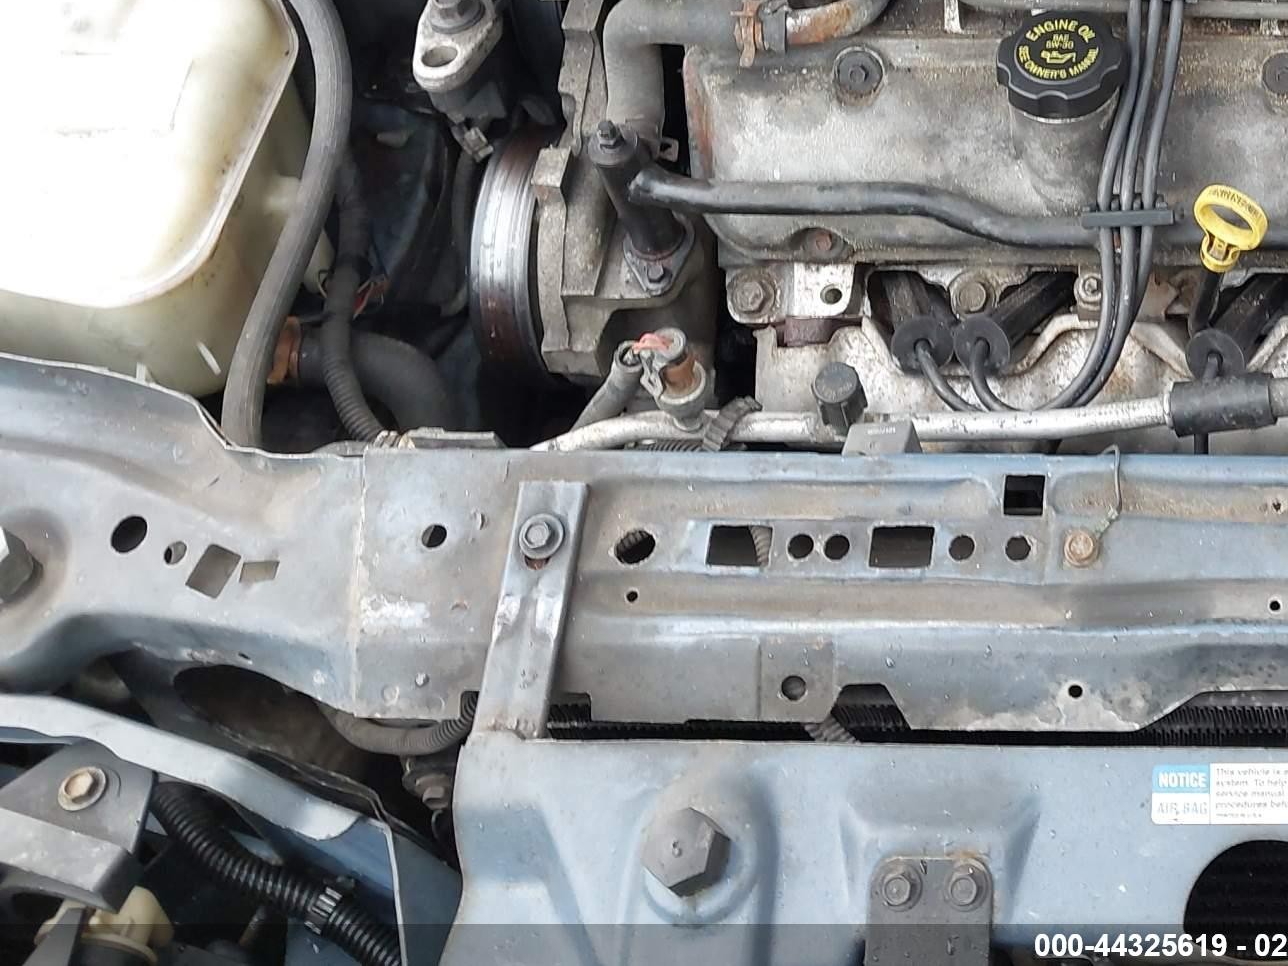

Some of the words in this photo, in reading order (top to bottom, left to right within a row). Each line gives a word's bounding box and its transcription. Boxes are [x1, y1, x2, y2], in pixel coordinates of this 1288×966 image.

[1025, 19, 1079, 42] ENGINE
[1078, 25, 1096, 43] OIL
[1019, 46, 1031, 63] SEE
[1025, 60, 1068, 80] OWNER'S
[1069, 46, 1099, 77] MANUAL
[1216, 767, 1235, 777] This
[1238, 767, 1270, 777] vehicle
[1272, 767, 1281, 777] is
[1158, 772, 1207, 788] NOTICE
[1255, 778, 1265, 787] To
[1267, 778, 1288, 789] help
[1216, 789, 1249, 797] service
[1252, 789, 1285, 797] manual
[1158, 802, 1180, 815] AIR
[1183, 802, 1208, 815] BAG
[1215, 799, 1268, 809] procedures
